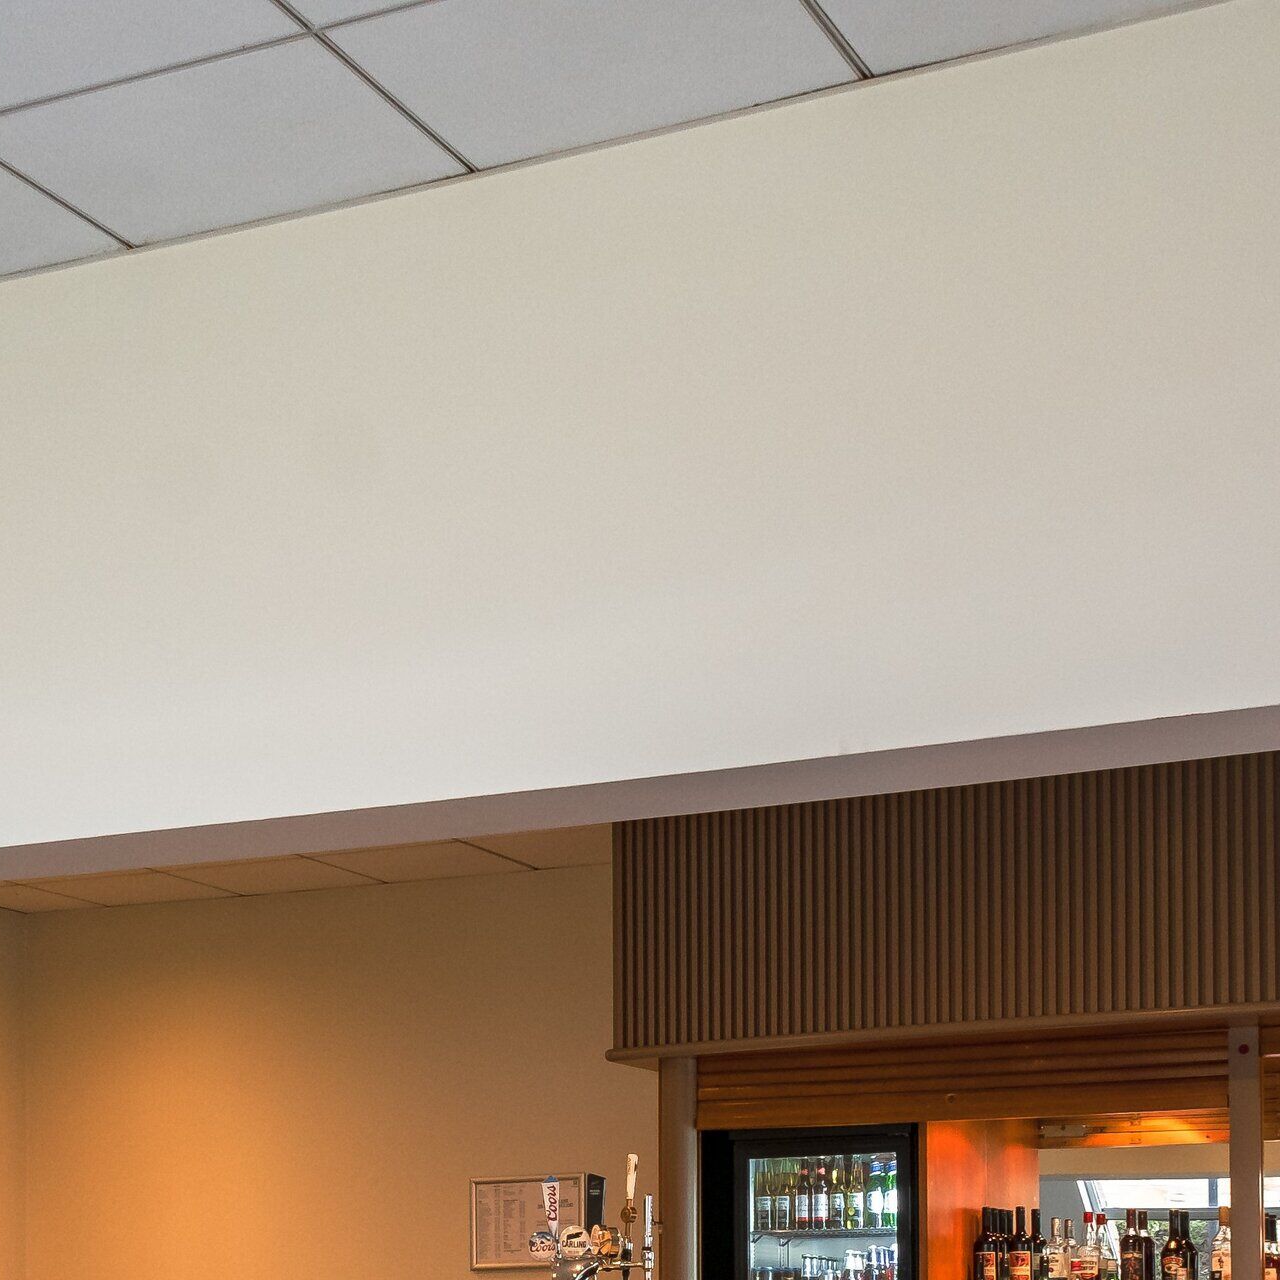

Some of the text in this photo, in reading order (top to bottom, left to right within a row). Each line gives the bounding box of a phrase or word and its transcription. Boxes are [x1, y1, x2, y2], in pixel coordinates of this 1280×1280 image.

[546, 1185, 558, 1221] Coors
[530, 1242, 556, 1253] Coors
[561, 1240, 587, 1248] CARLING
